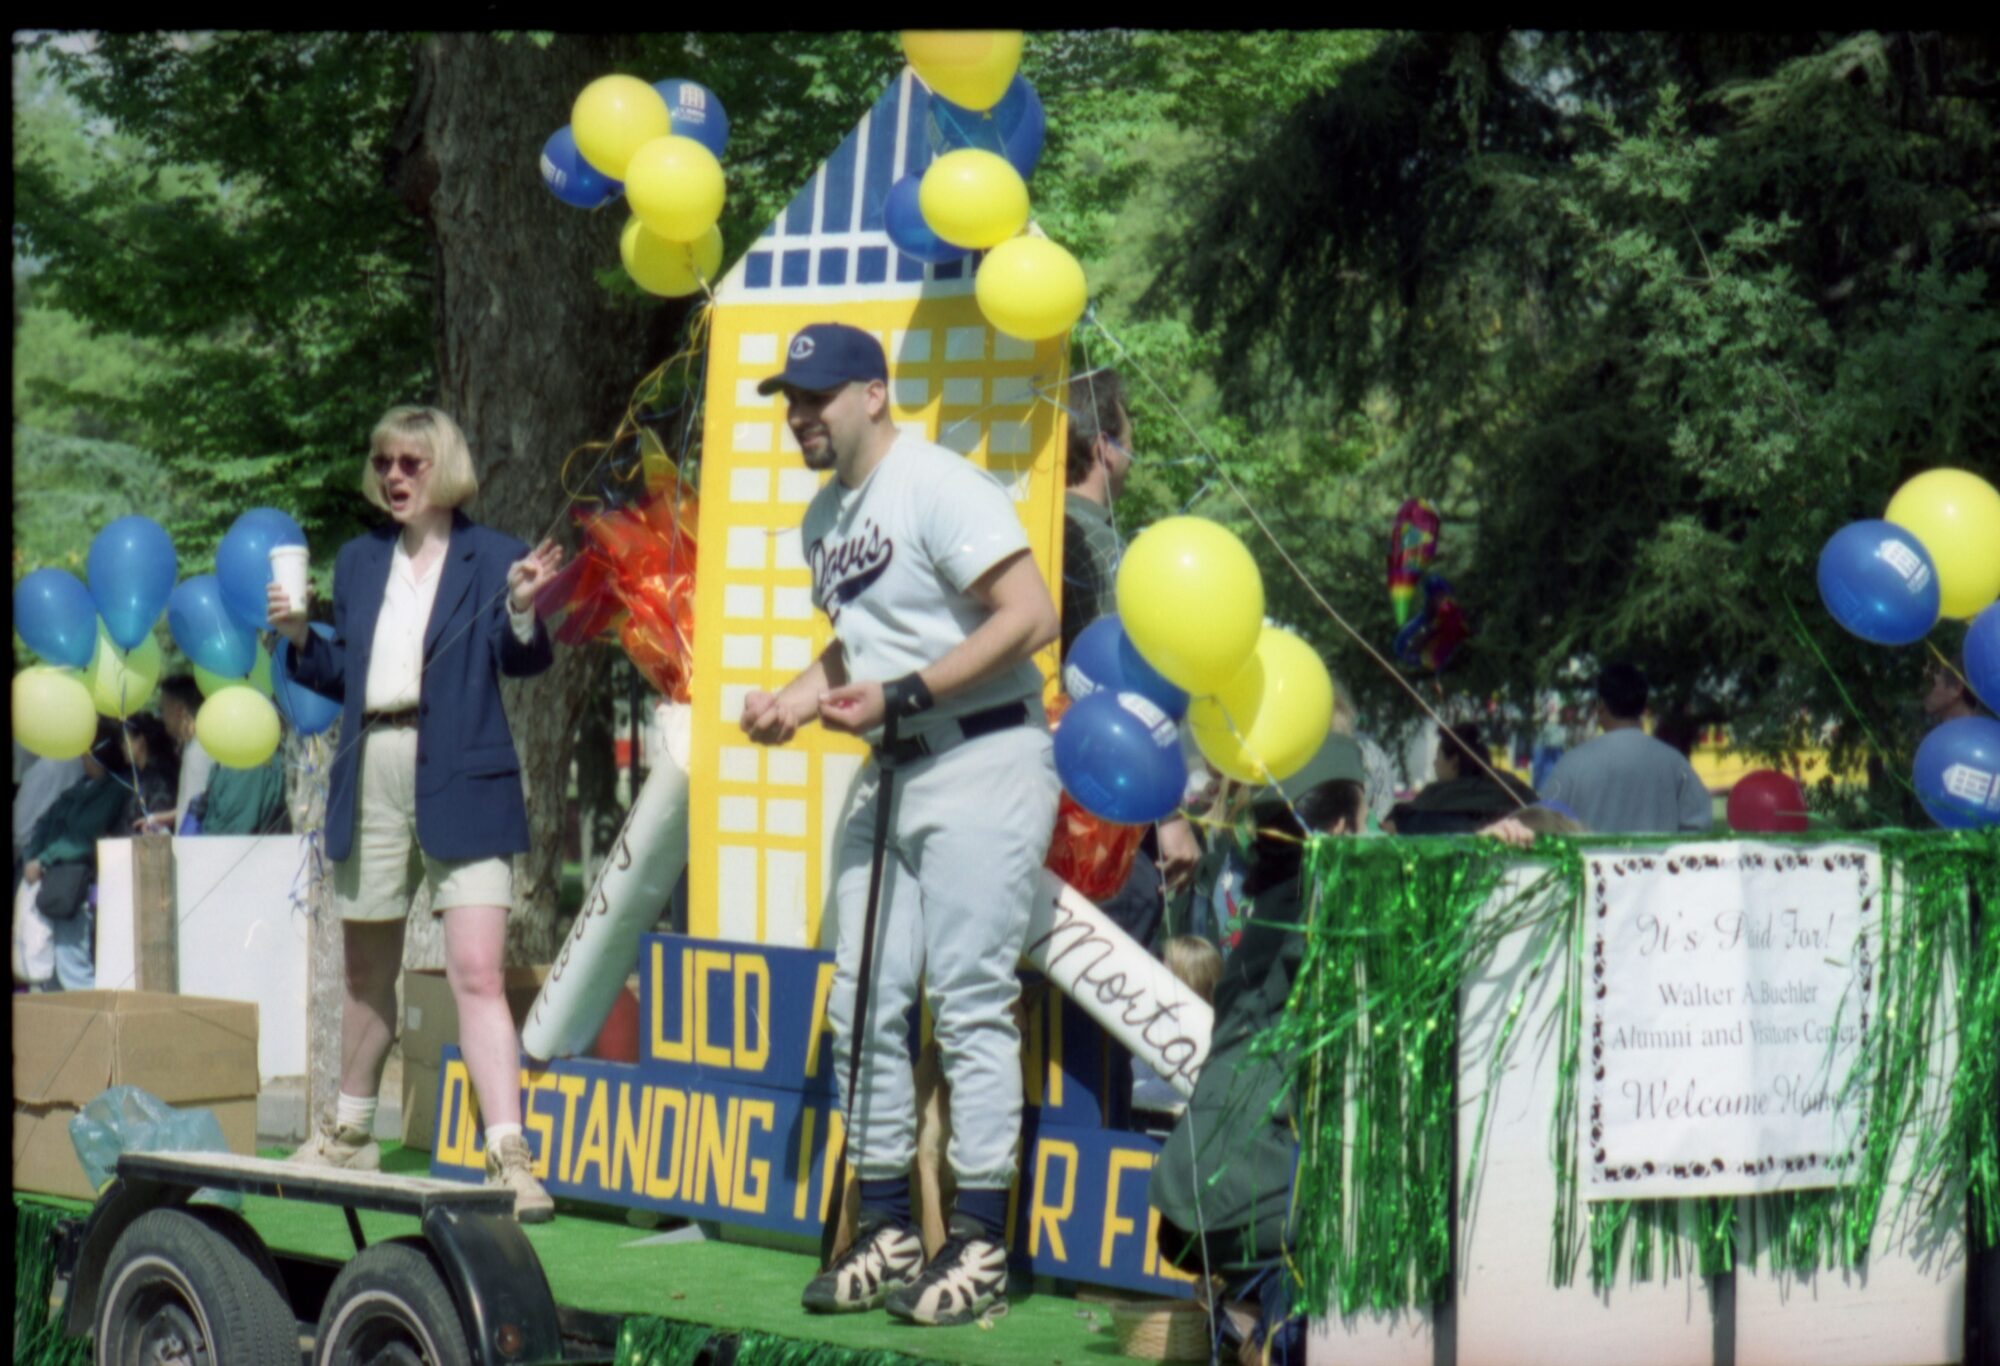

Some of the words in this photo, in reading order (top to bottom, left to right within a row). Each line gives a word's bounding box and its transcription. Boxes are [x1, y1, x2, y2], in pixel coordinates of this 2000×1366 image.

[1635, 911, 1699, 957] It's
[1781, 907, 1836, 950] For!
[651, 941, 771, 1072] UCD
[1658, 982, 1736, 1008] Walter
[1611, 1023, 1692, 1051] Alumni
[1701, 1020, 1744, 1047] and
[1749, 1018, 1799, 1046] Visitors
[1621, 1076, 1772, 1120] Welcome
